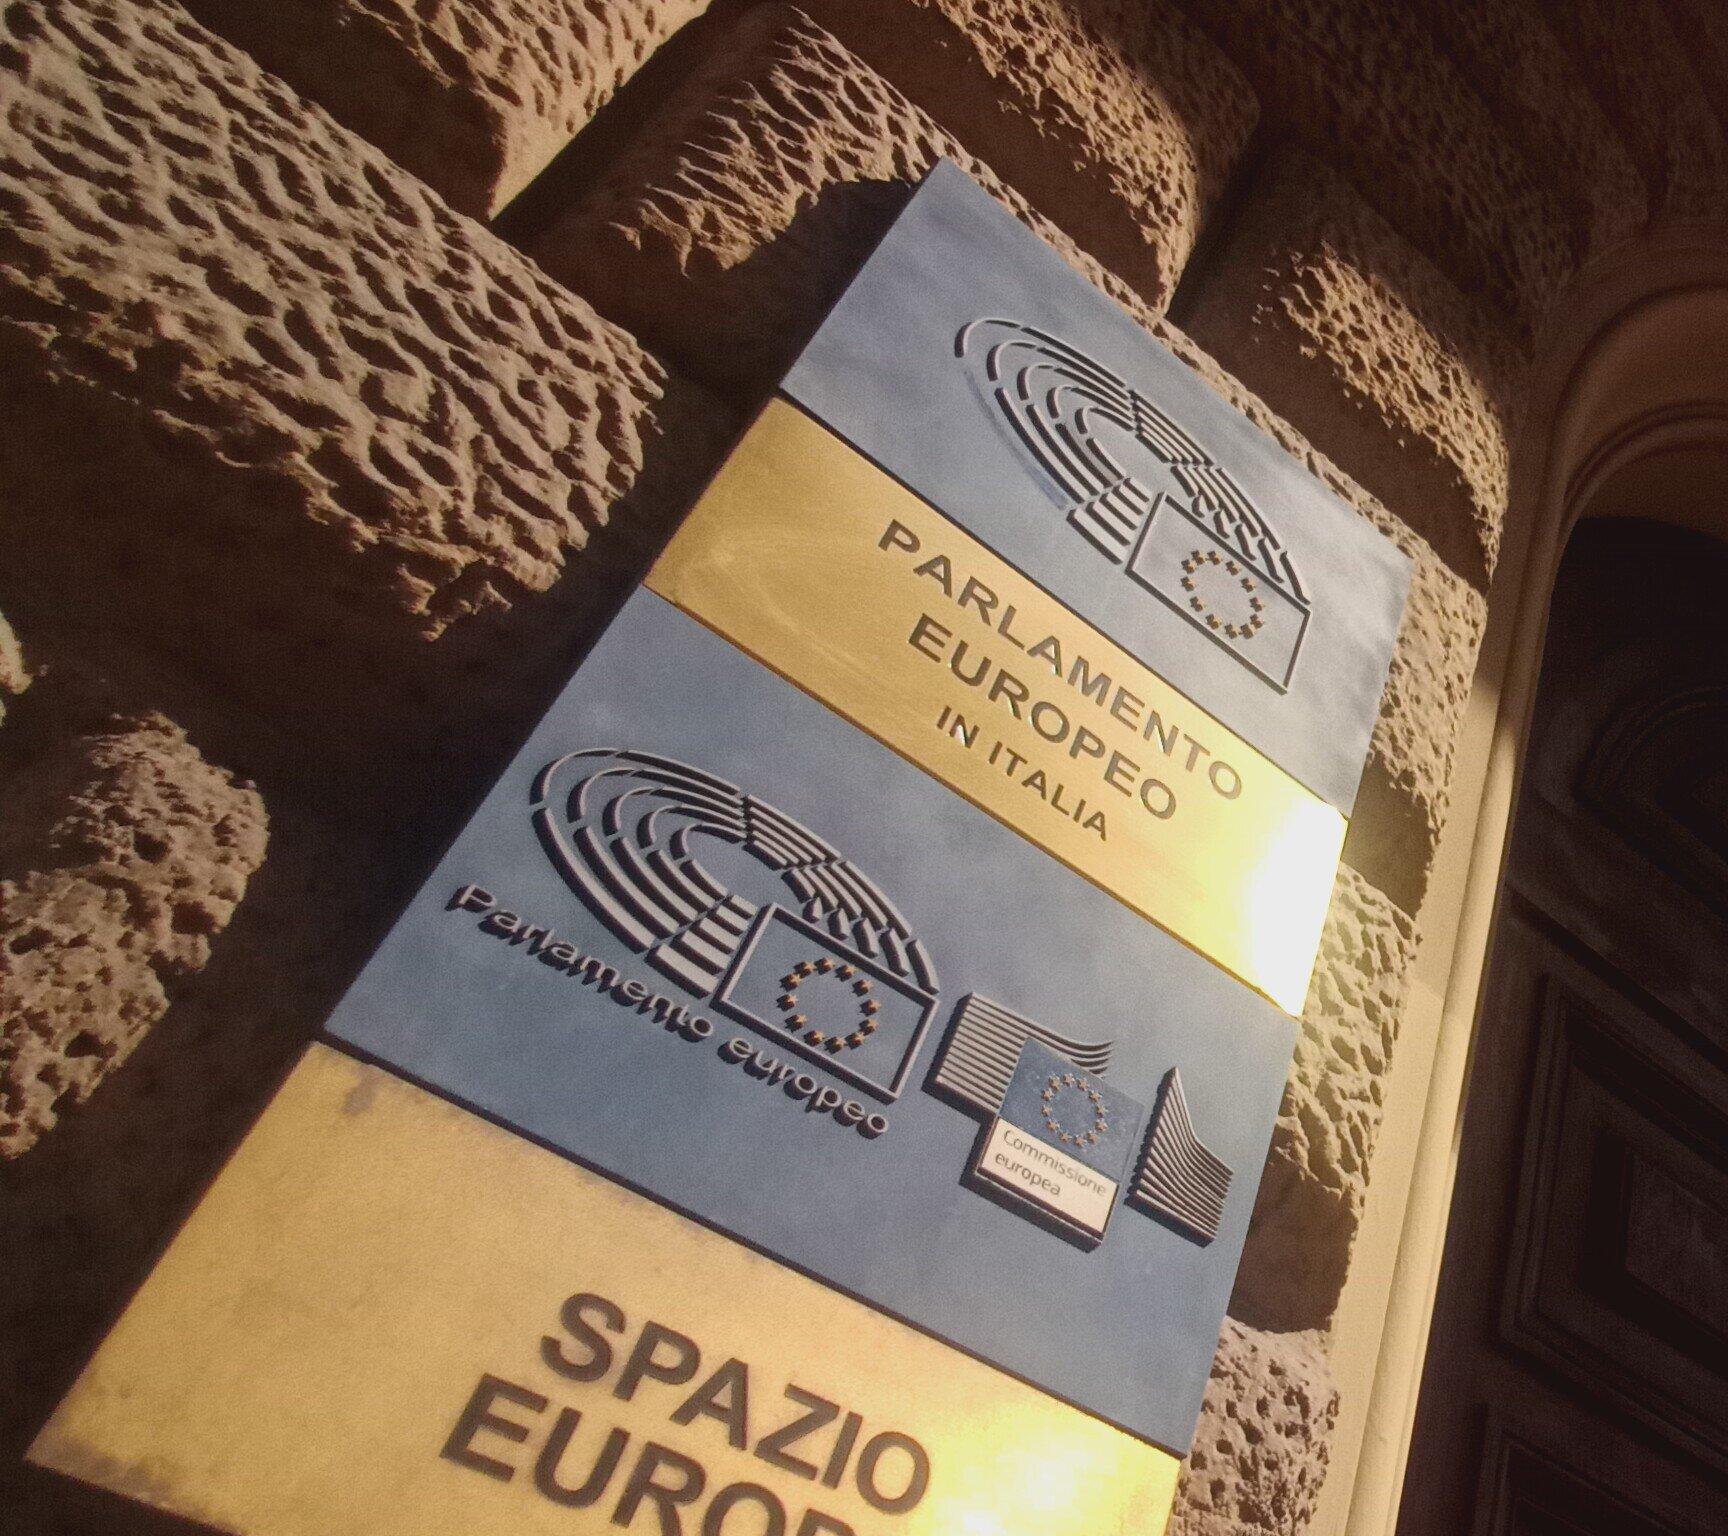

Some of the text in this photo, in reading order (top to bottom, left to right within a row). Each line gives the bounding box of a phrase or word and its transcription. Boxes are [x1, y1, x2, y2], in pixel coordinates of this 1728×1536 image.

[877, 518, 1244, 801] PARLAMENTO
[908, 613, 1178, 821] EUROPEO
[936, 704, 1109, 842] IN ITALIA
[448, 883, 889, 1138] Parlamento europeo
[994, 1152, 1062, 1196] europea
[1003, 1129, 1107, 1197] Commissione
[538, 1290, 932, 1517] SPAZIO
